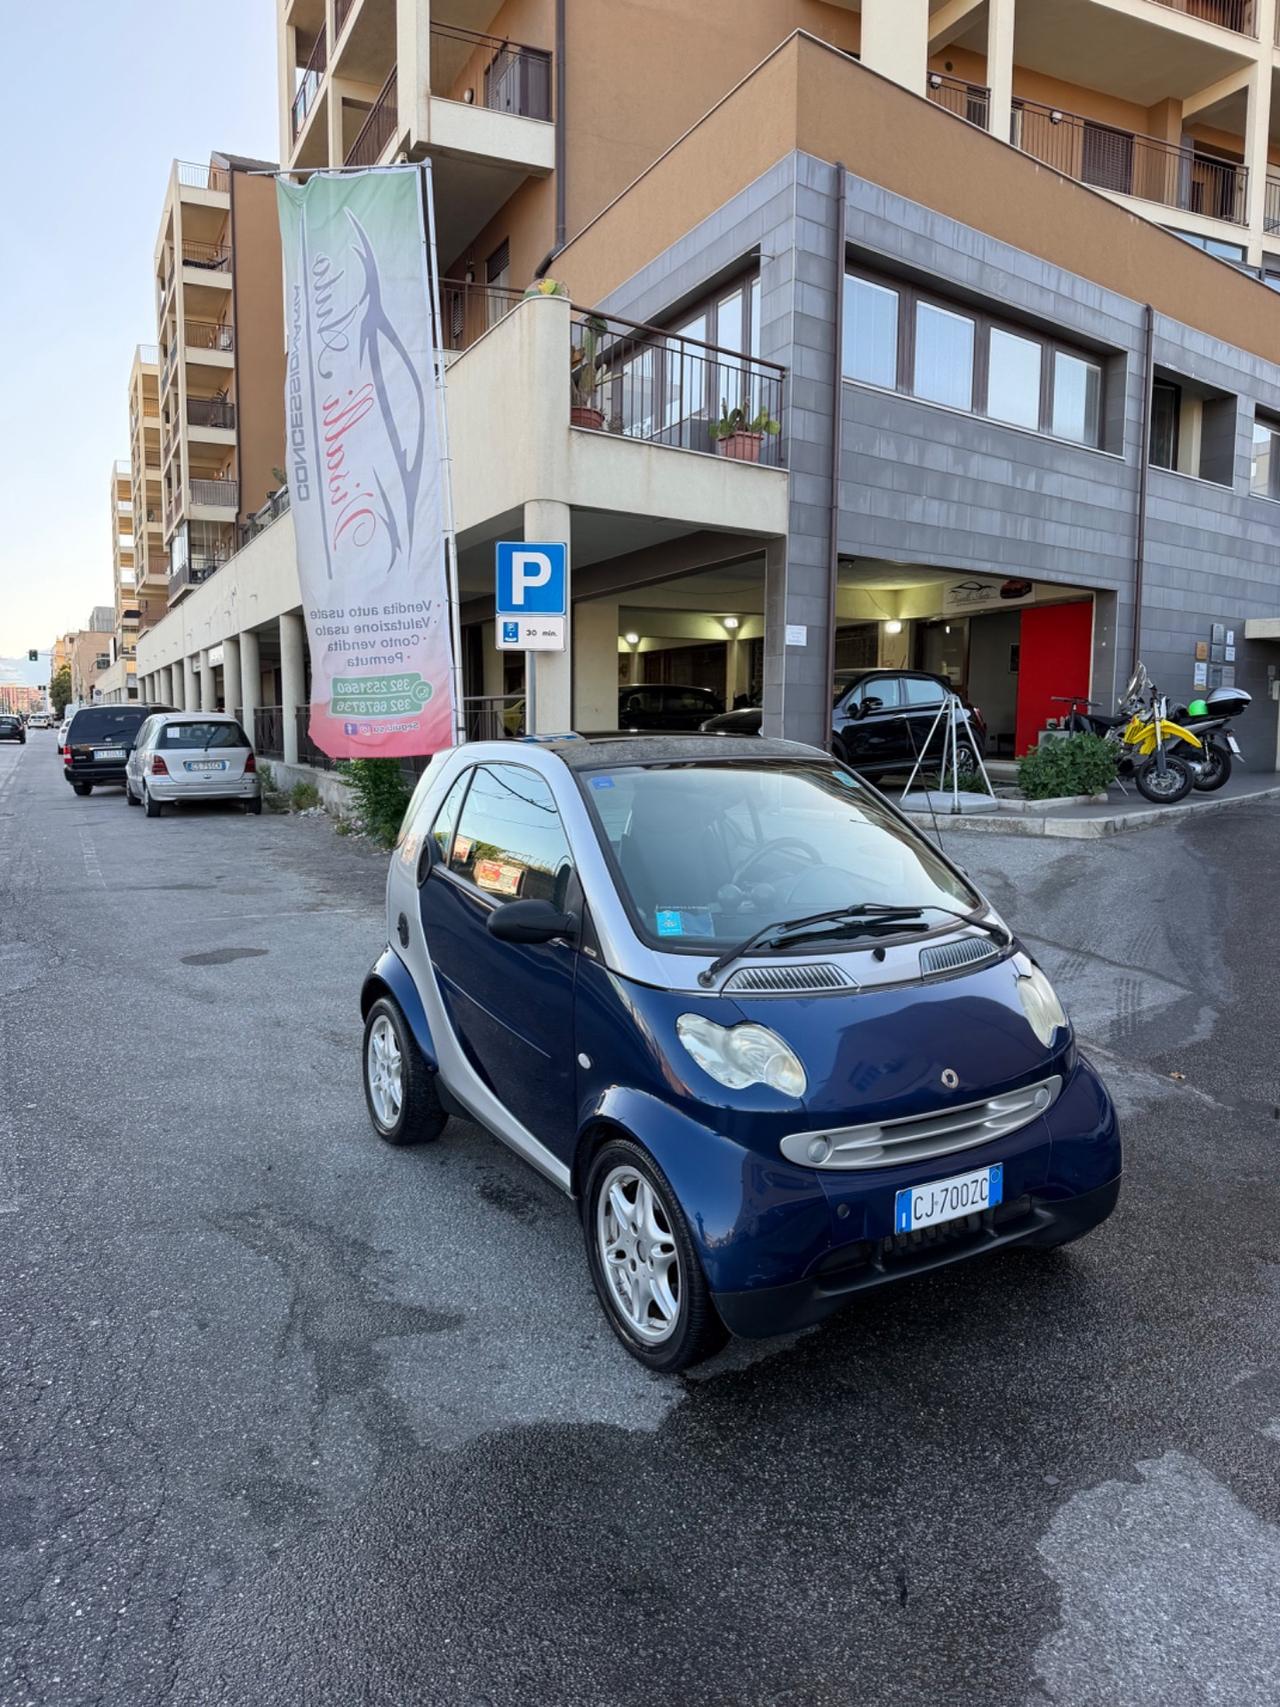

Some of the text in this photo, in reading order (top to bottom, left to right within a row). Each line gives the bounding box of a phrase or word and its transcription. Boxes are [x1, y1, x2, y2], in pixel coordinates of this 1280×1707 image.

[512, 551, 552, 605] P
[525, 629, 558, 637] 30 min.
